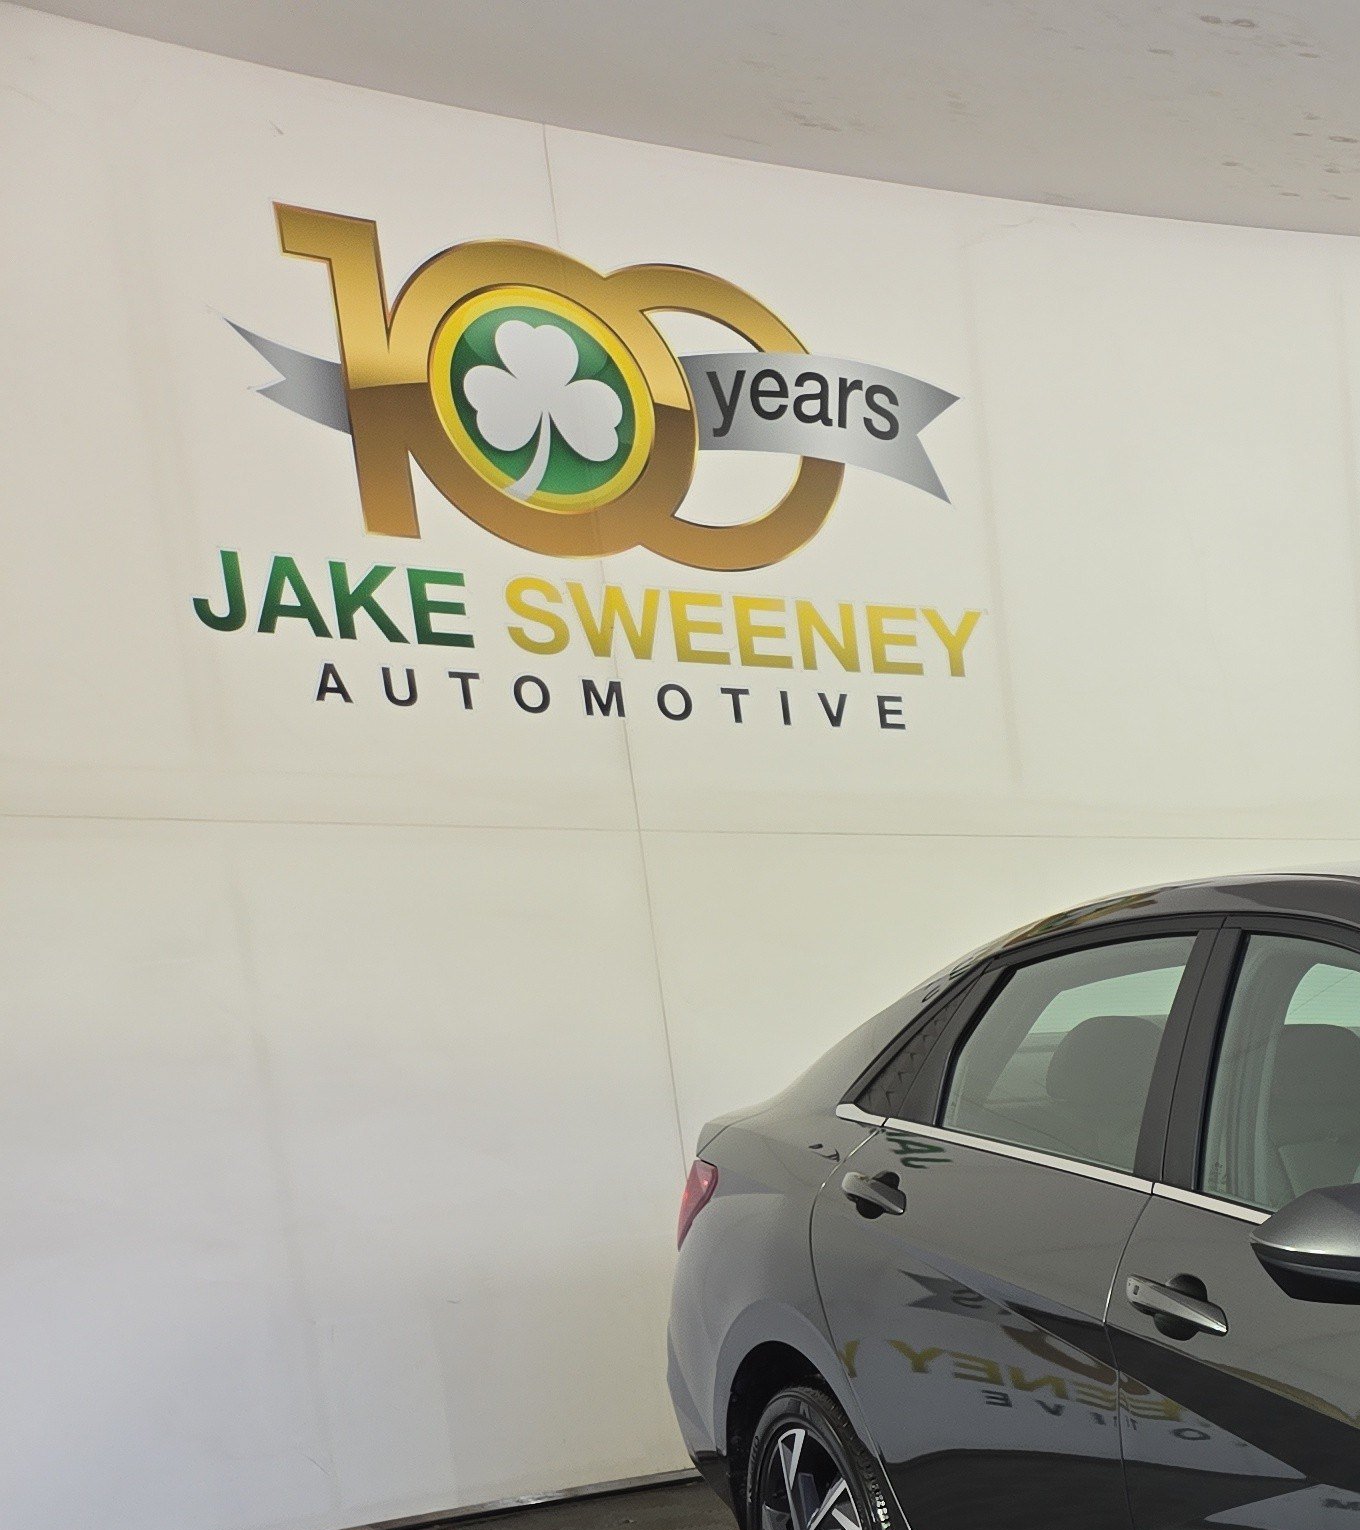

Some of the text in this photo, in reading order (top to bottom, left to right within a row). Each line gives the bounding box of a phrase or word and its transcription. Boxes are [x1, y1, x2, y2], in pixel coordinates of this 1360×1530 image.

[272, 201, 902, 572] 100 years
[193, 550, 983, 678] JAKE SWEENEY
[314, 662, 908, 731] AUTOMOTIVE
